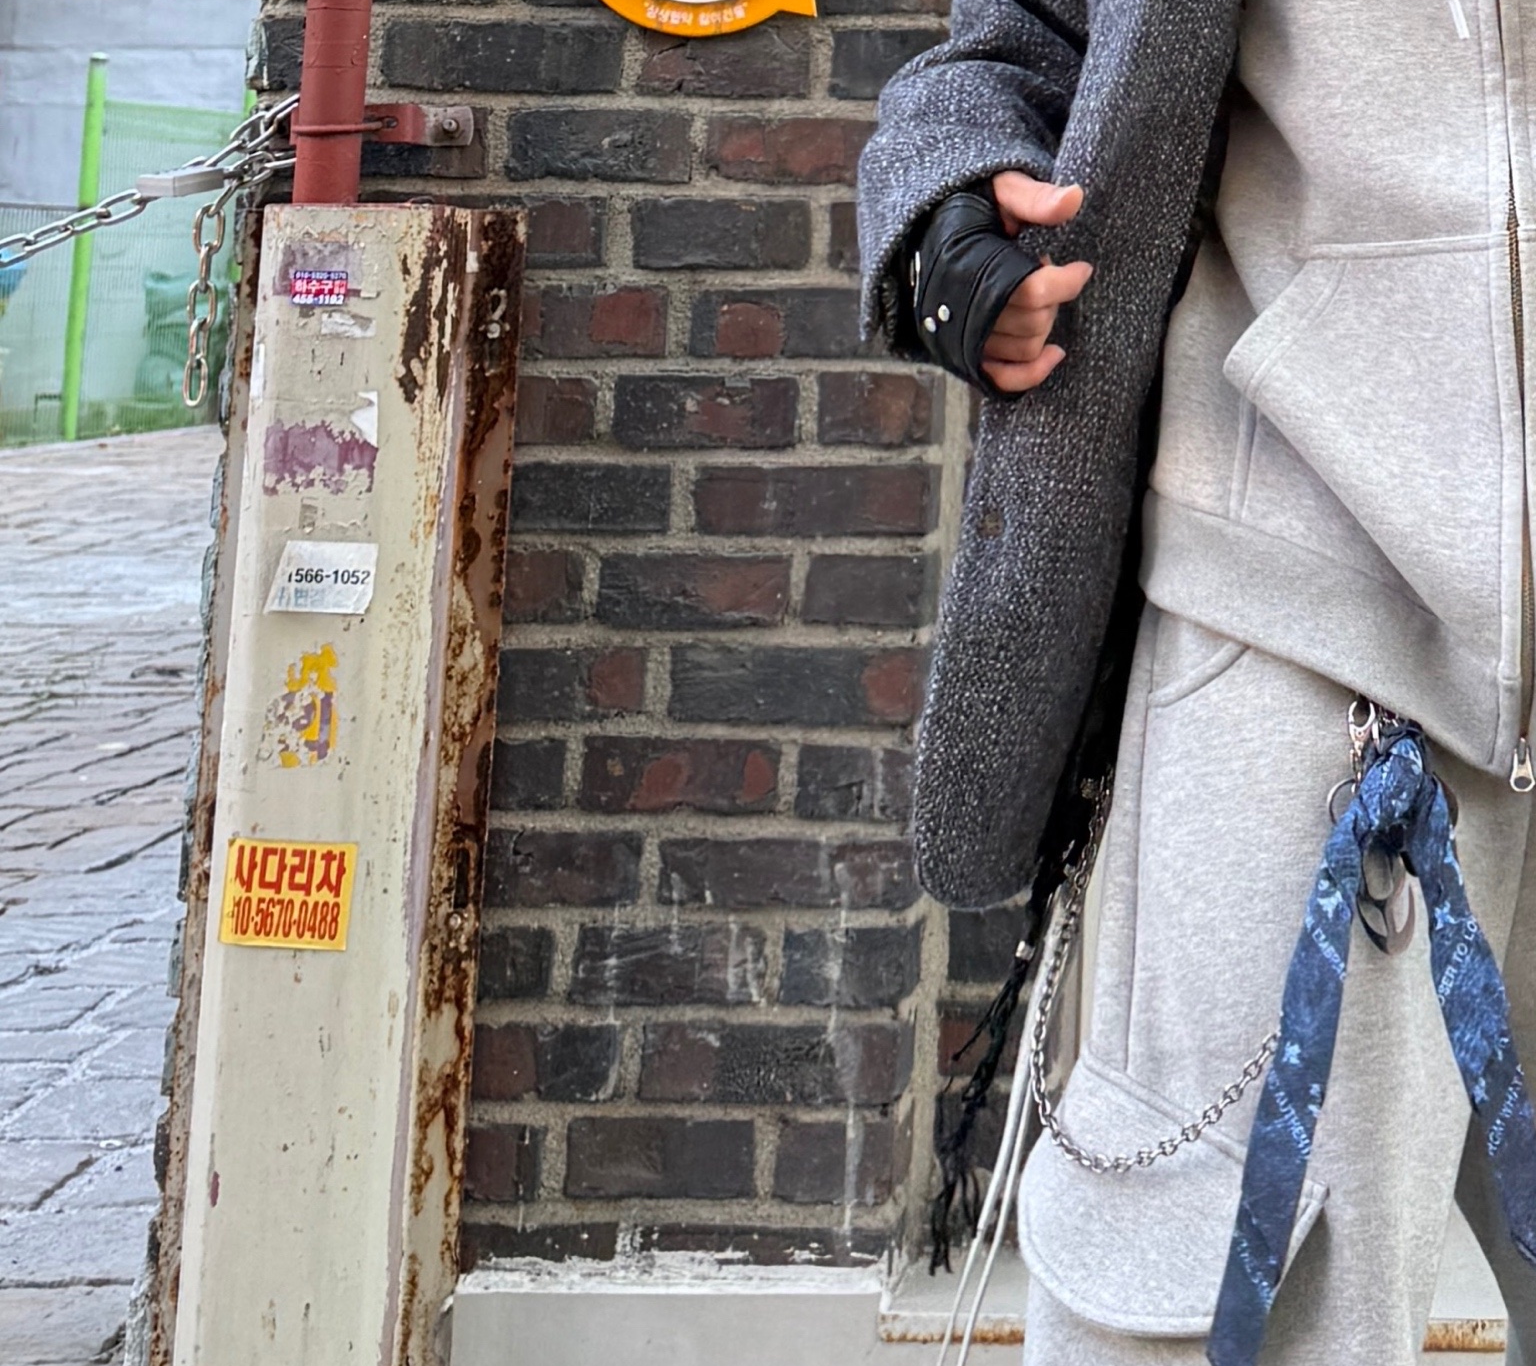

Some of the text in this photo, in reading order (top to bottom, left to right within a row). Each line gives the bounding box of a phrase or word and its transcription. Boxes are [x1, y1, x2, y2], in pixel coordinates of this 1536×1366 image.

[287, 567, 371, 586] 1566-1052
[234, 845, 347, 898] 사다리차
[1452, 942, 1469, 963] TO
